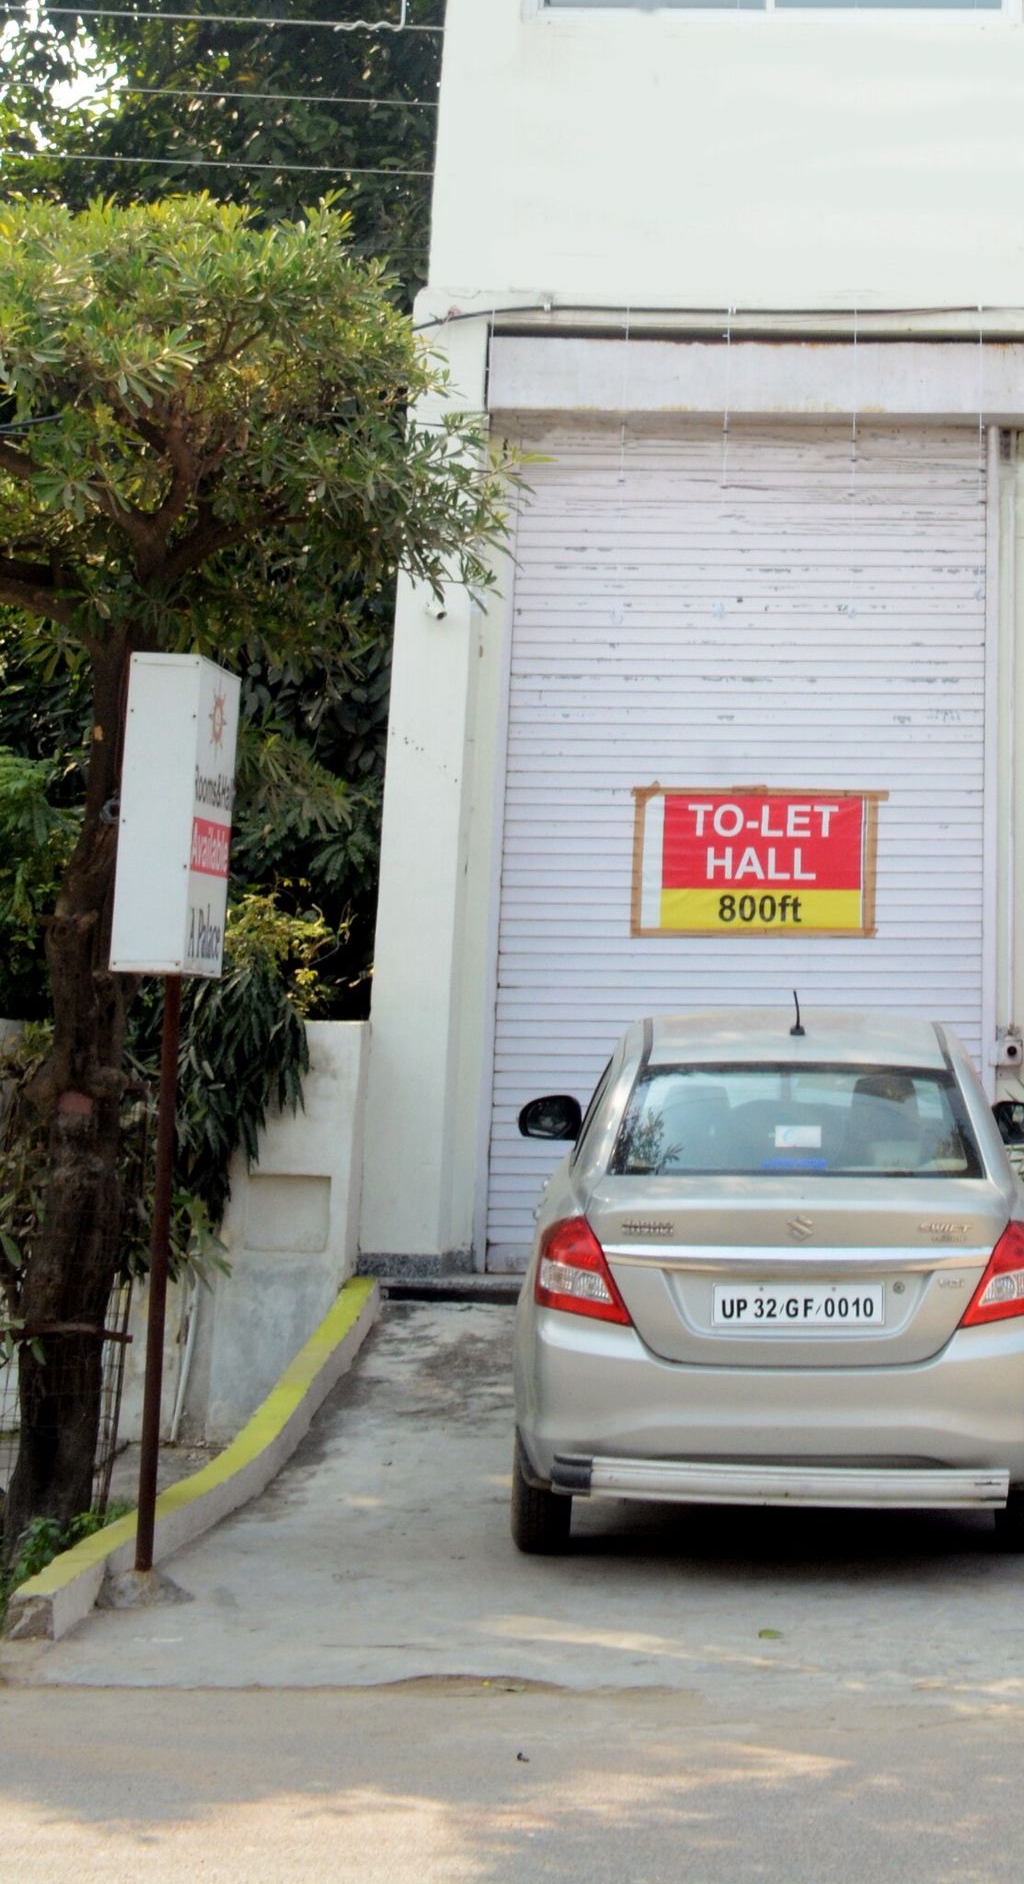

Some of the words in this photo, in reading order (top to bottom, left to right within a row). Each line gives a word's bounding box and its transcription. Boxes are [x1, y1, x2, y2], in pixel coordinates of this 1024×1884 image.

[688, 803, 839, 838] TO-LET
[191, 822, 229, 873] Available
[705, 846, 817, 881] HALL
[718, 894, 802, 923] 800ft
[188, 908, 195, 958] A
[197, 903, 221, 962] Palace
[721, 1298, 748, 1319] UP
